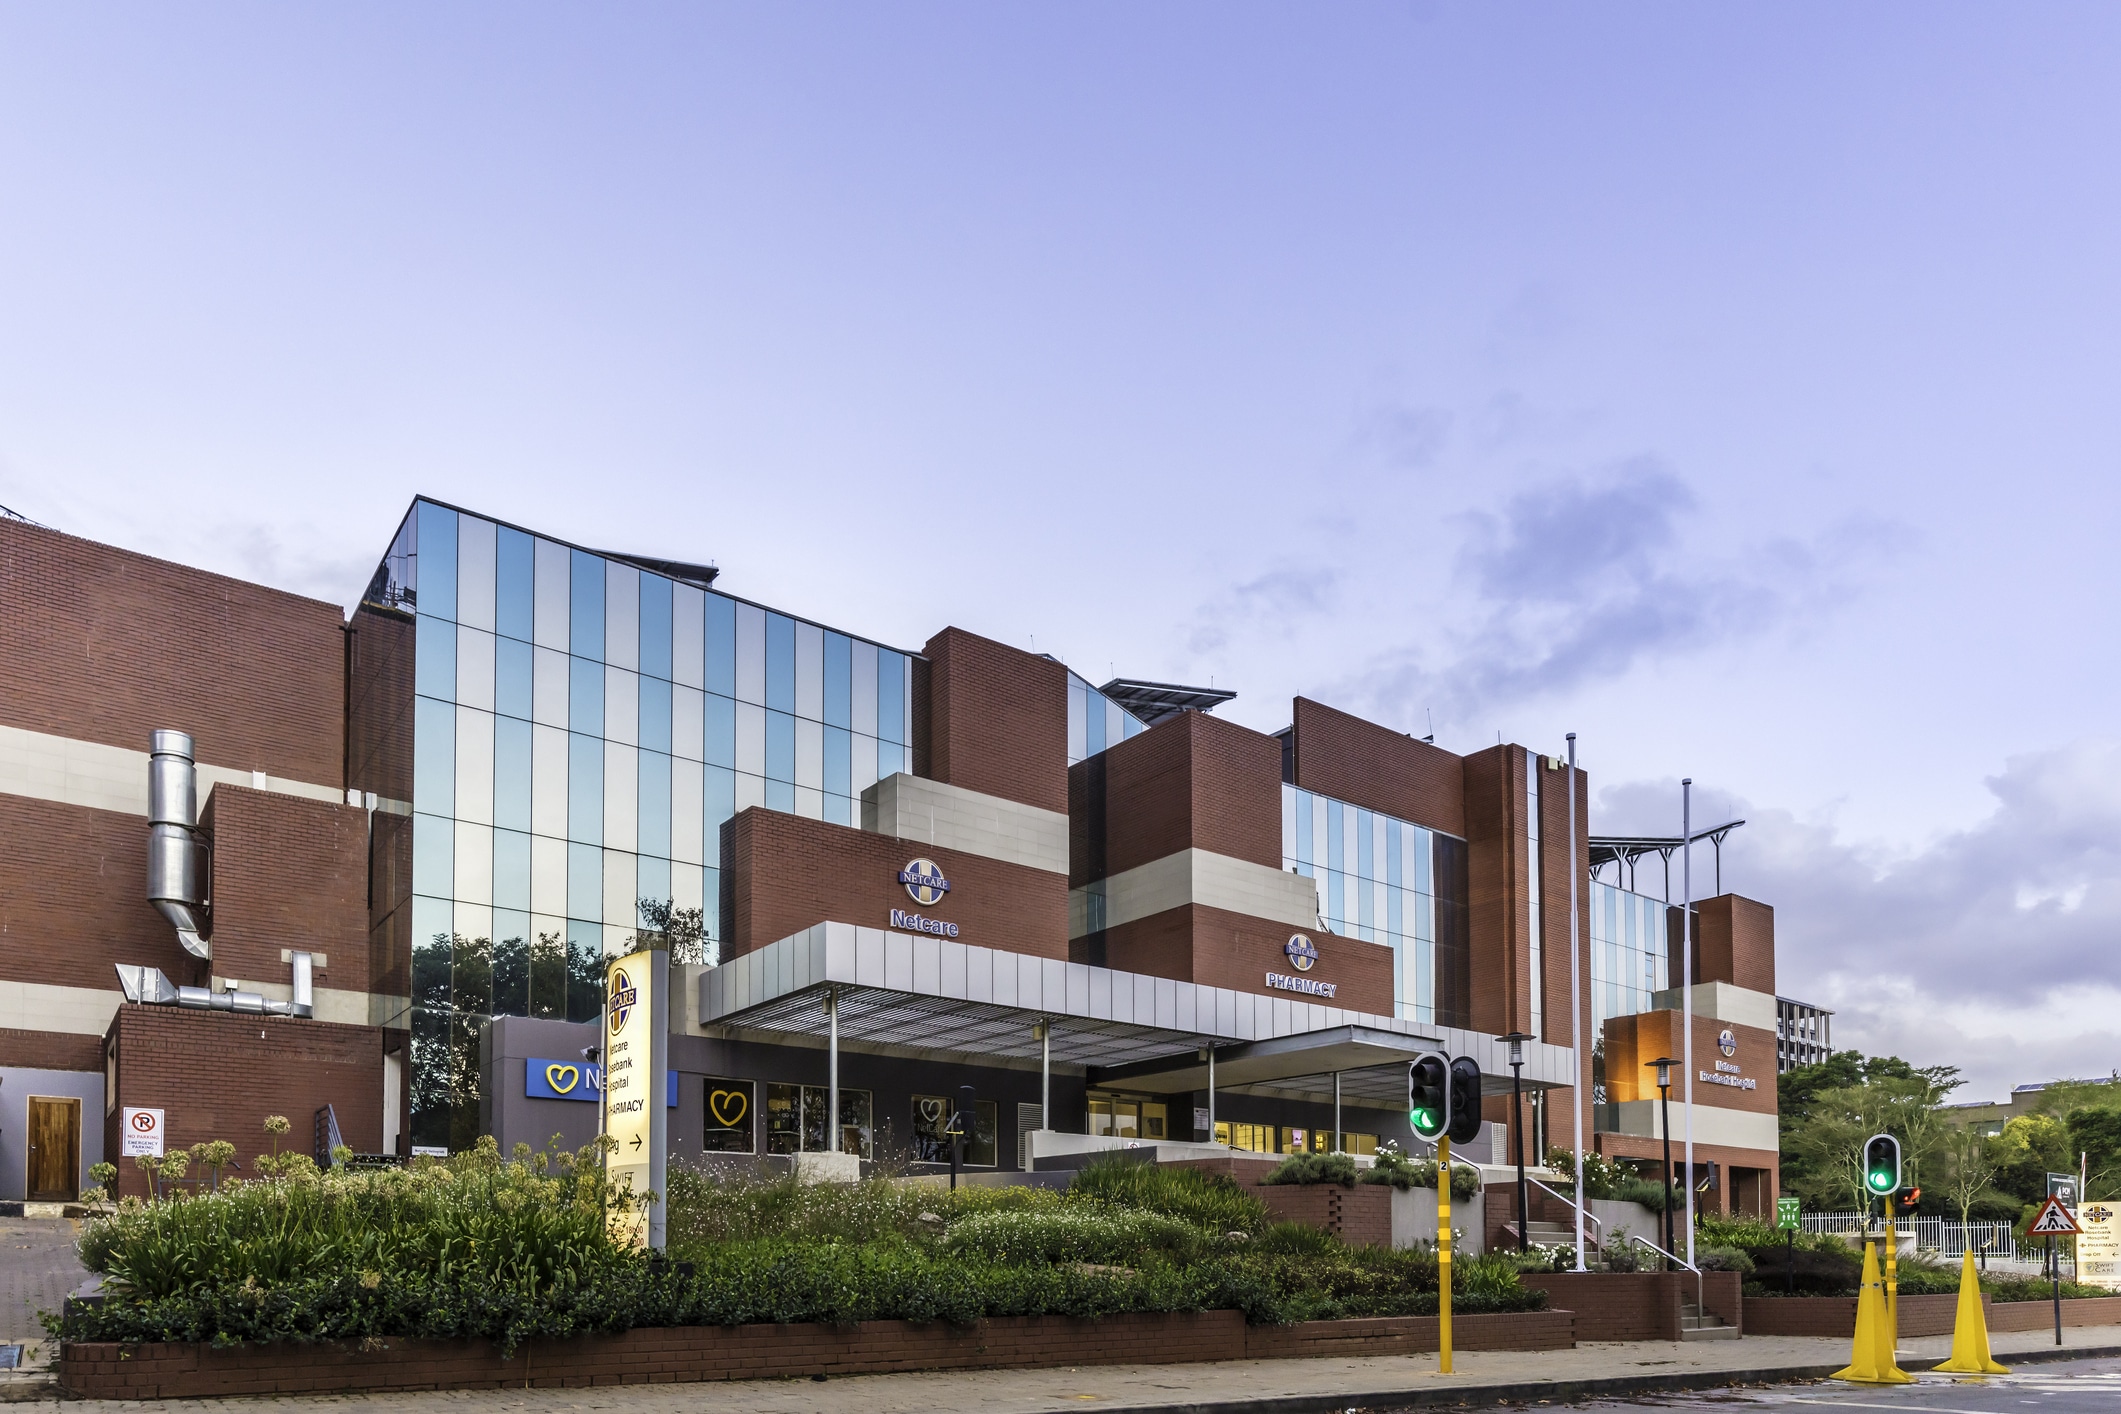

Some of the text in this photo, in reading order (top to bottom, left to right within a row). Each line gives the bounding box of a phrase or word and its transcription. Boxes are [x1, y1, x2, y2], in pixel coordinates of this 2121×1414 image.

[902, 872, 949, 890] NETCARE
[890, 908, 959, 938] Netcare
[1288, 946, 1317, 958] NETCARE
[1266, 972, 1337, 998] PHARMACY
[607, 990, 635, 1013] ETCARE
[609, 1040, 629, 1056] etcare
[608, 1057, 633, 1075] osebank
[608, 1076, 629, 1094] ospital
[1441, 1161, 1447, 1171] 2
